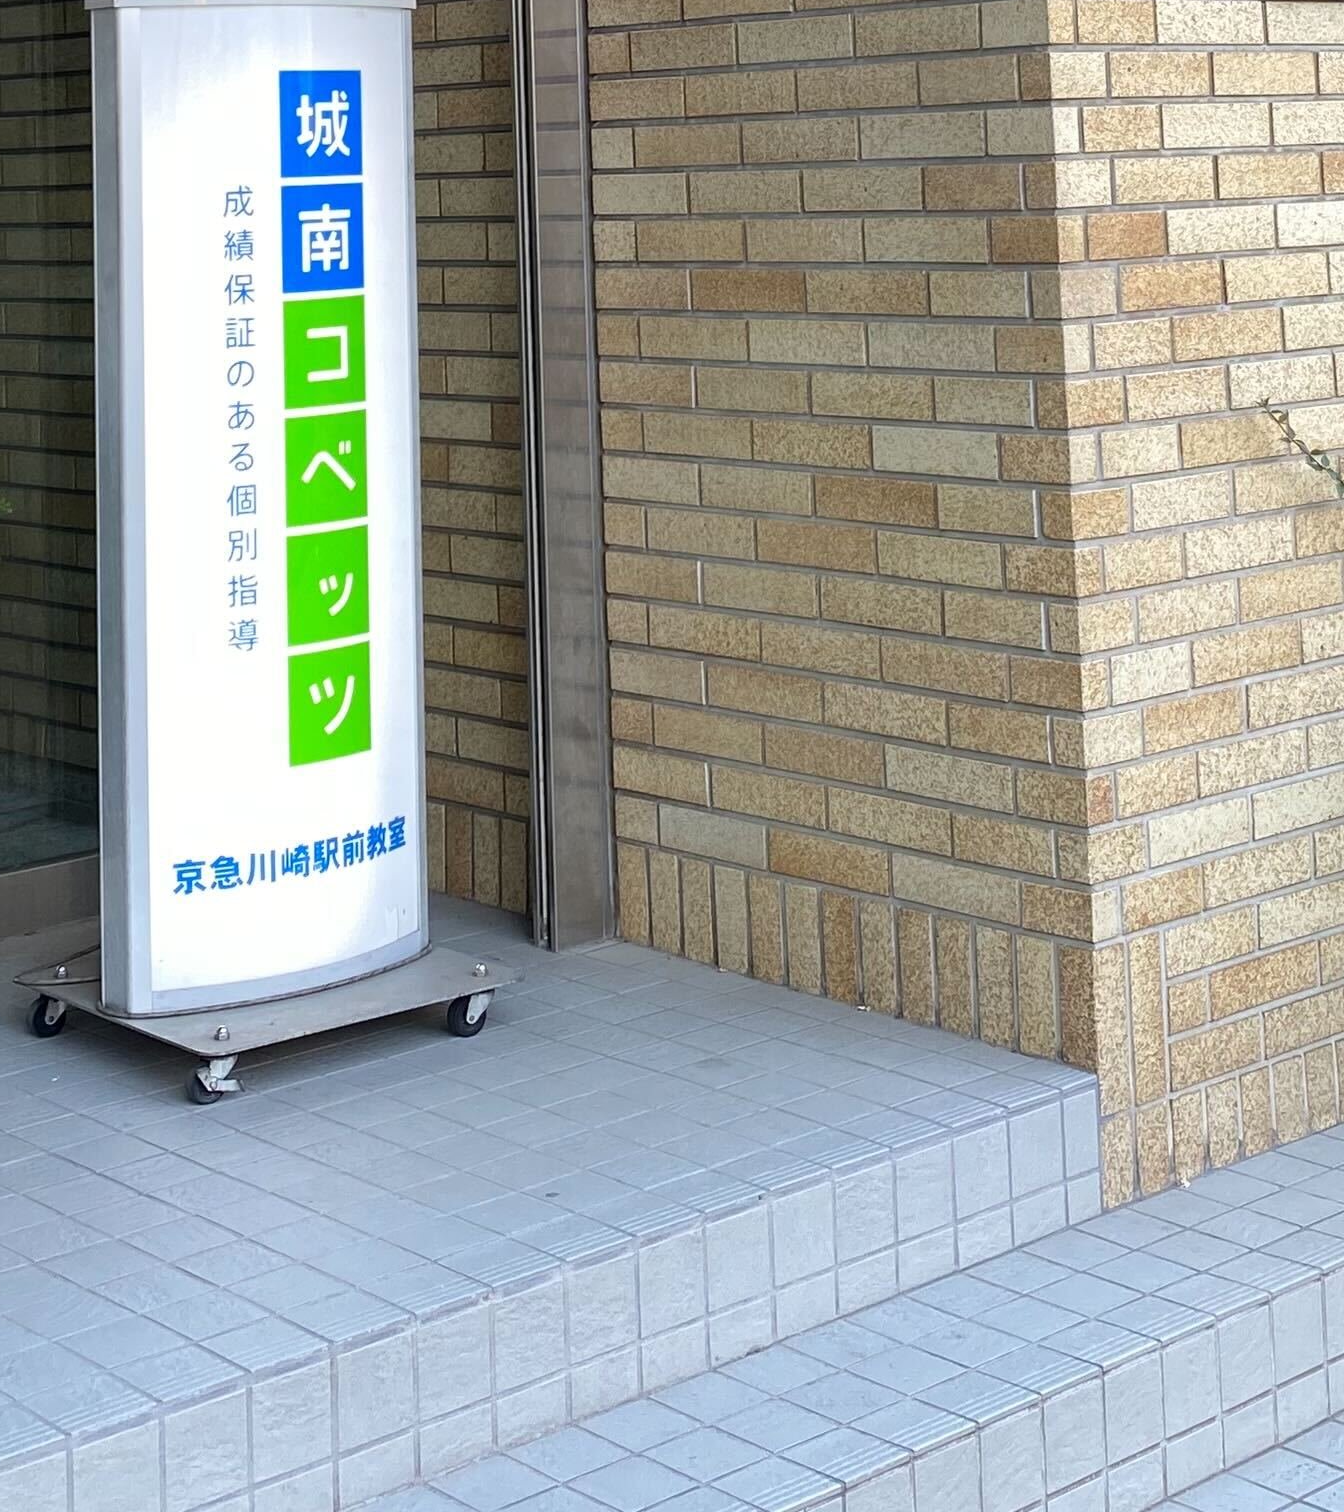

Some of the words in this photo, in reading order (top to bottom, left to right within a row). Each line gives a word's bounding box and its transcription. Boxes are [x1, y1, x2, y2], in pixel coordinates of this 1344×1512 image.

[223, 183, 259, 652] 成績保証のある個別指導
[294, 88, 359, 736] 城南コベッツ
[172, 815, 407, 895] 京急川崎駅前教室
